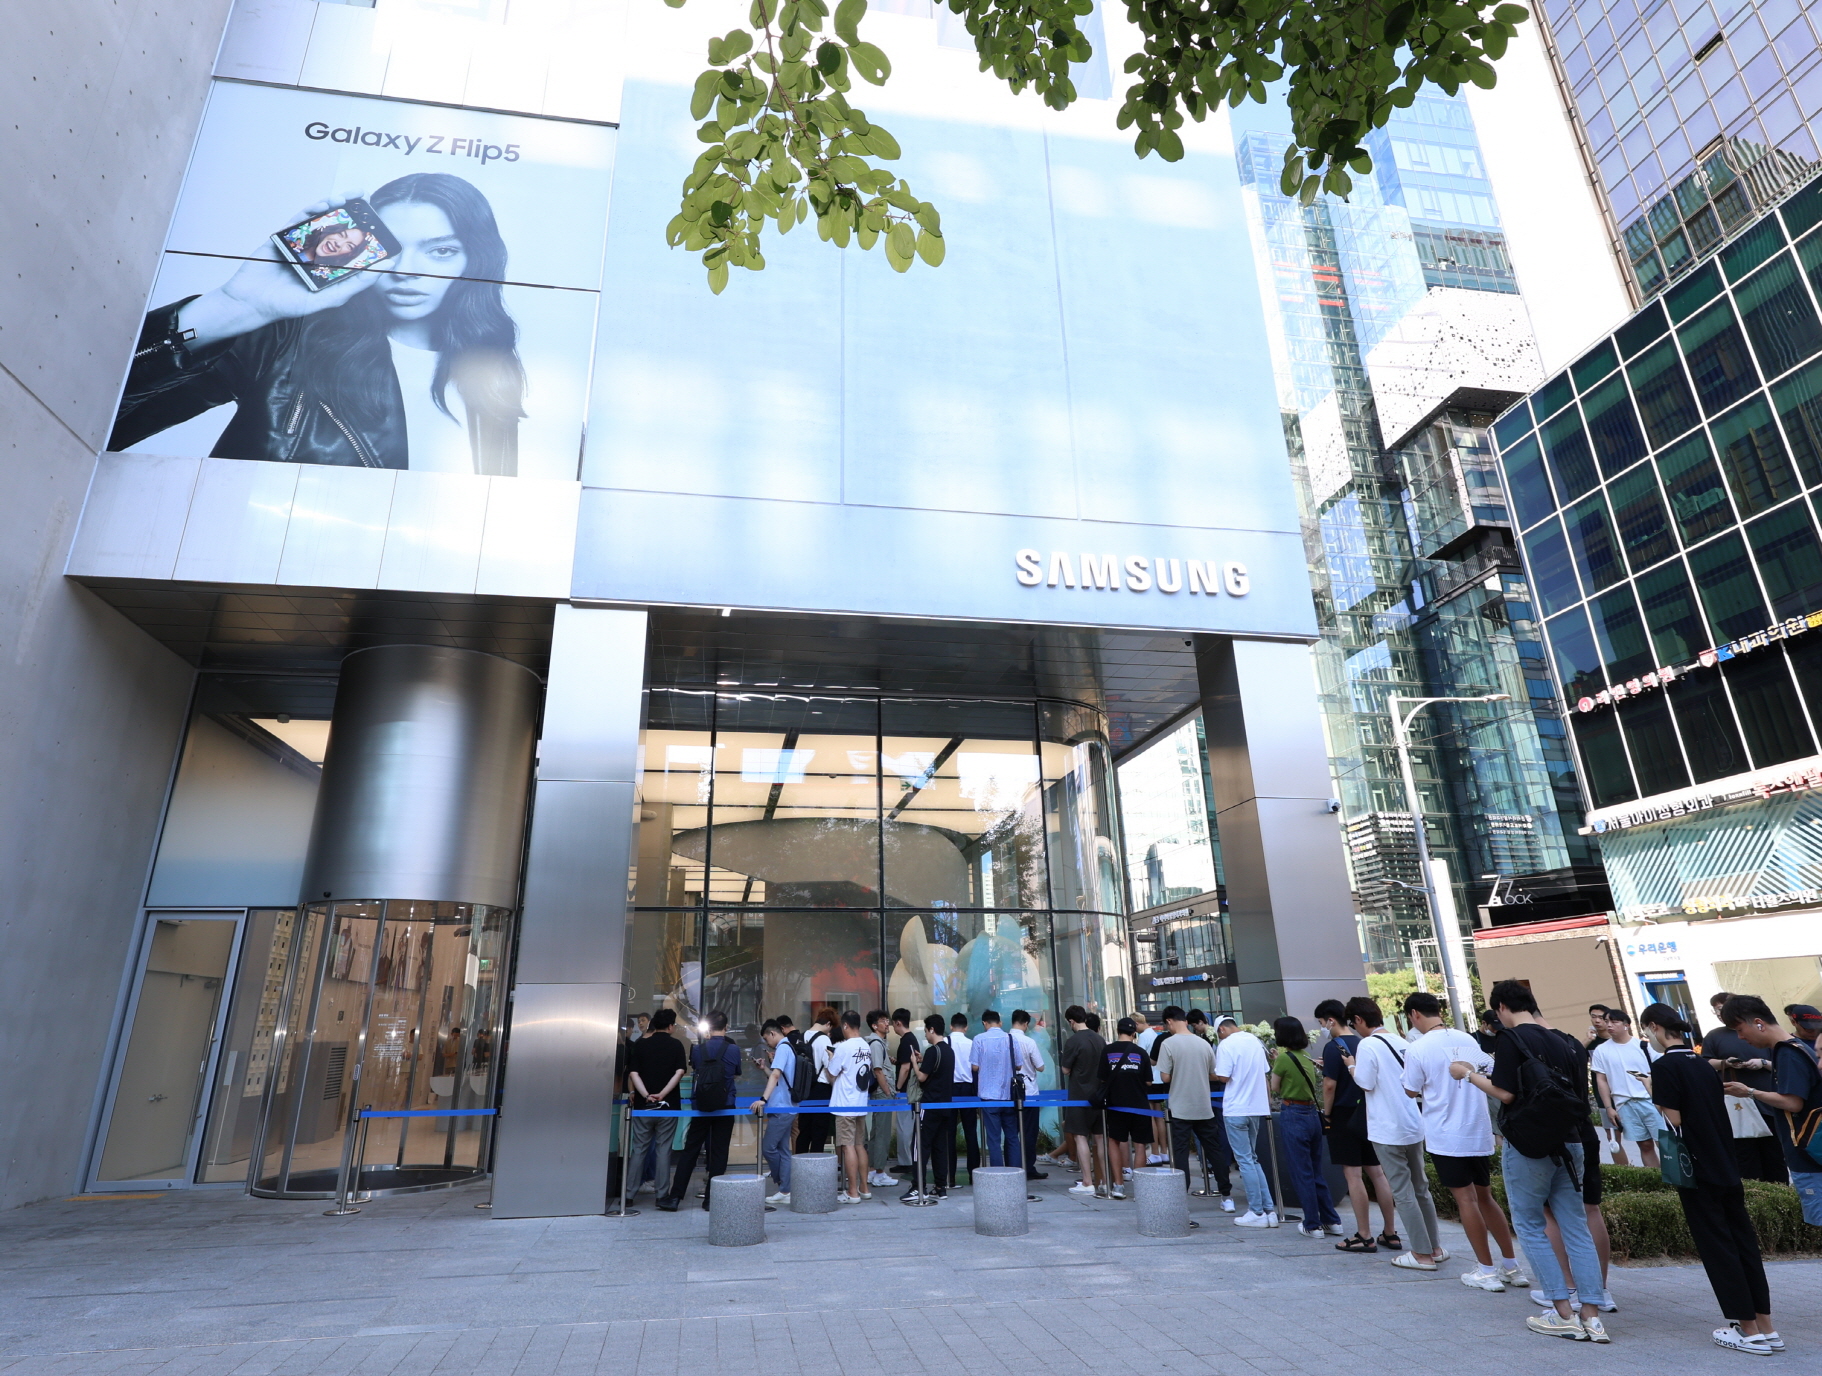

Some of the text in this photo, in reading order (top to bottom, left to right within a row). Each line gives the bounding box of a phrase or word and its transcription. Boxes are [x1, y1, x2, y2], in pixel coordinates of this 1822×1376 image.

[304, 121, 521, 166] Galaxy Z Flip5
[1015, 548, 1251, 598] SAMSUNG
[1638, 941, 1678, 955] 우리은행
